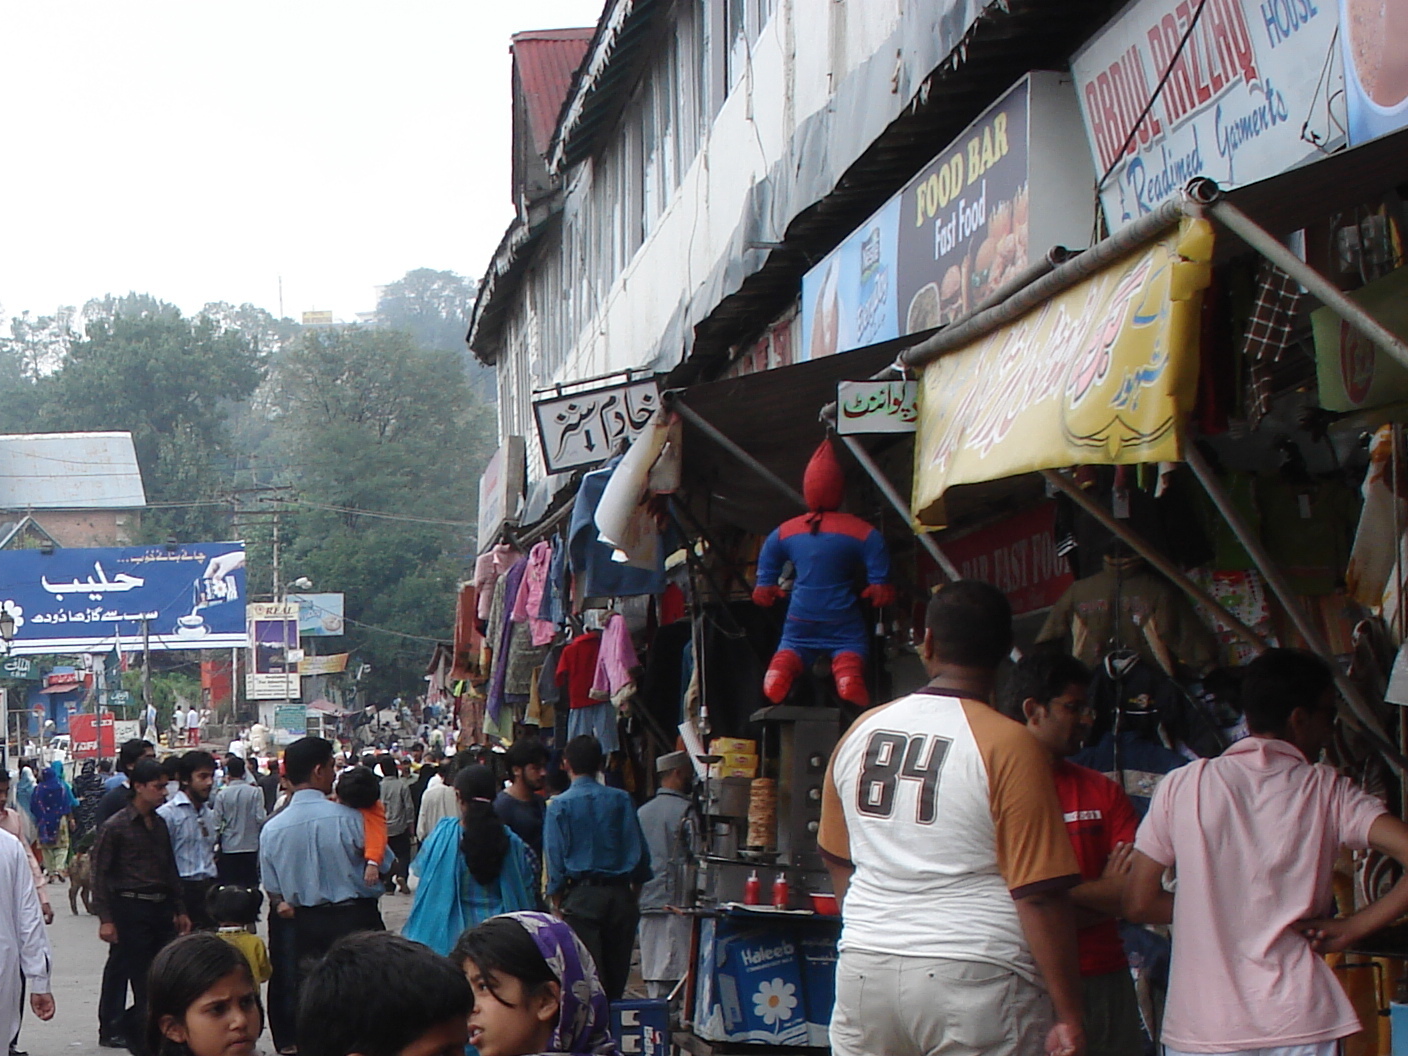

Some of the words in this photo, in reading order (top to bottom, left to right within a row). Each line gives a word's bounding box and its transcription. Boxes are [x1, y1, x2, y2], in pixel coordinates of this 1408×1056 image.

[1085, 45, 1163, 174] ABDUL
[1148, 0, 1258, 126] RAZZAQ
[915, 152, 964, 228] FOOD
[967, 112, 1009, 186] BAR
[1215, 78, 1289, 187] Garments
[934, 215, 957, 261] Fast
[958, 178, 987, 243] Food
[600, 388, 657, 451] خادم
[41, 560, 145, 602] حلیب
[994, 537, 1029, 594] FAST
[1031, 530, 1073, 584] FOO
[856, 728, 955, 826] 84
[741, 940, 794, 966] Haleeb
